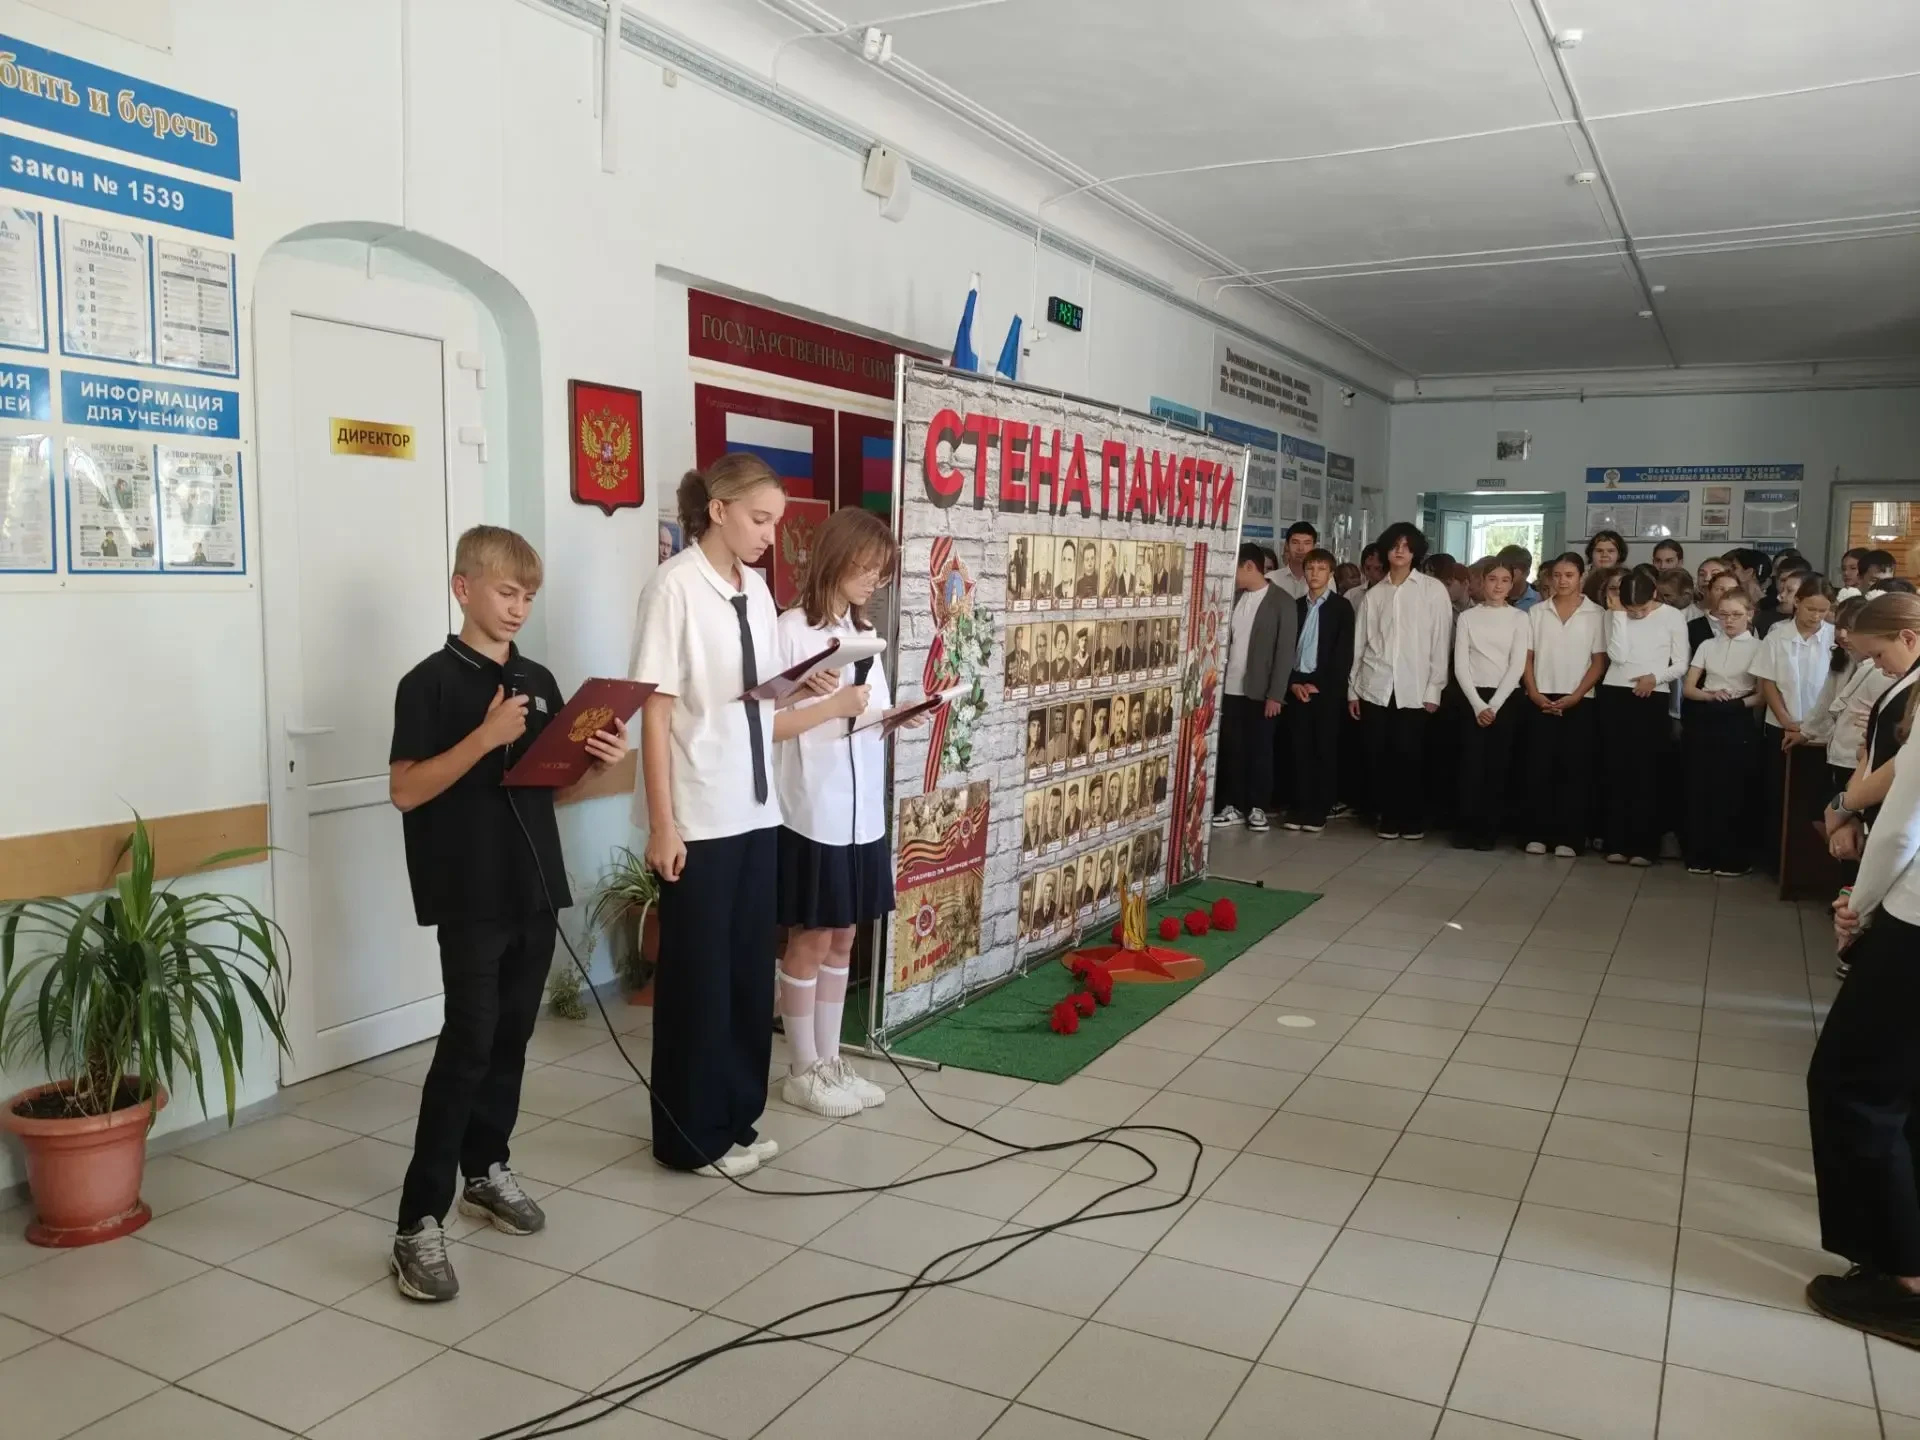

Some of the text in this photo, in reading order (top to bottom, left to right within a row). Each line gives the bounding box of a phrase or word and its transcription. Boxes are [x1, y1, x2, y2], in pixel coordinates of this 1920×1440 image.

[87, 87, 111, 117] и
[117, 89, 218, 147] беречь
[10, 155, 185, 211] закон № 1539
[80, 239, 130, 256] ПРАВИЛА
[701, 314, 855, 374] ГОСУДАРСТВЕННАЯ
[81, 381, 224, 412] ИНФОРМАЦИЯ
[86, 406, 219, 431] ДЛЯ УЧЕНИКОВ
[337, 427, 411, 448] ДИРЕКТОР
[924, 408, 1235, 530] СТЕНА ПАМЯТИ
